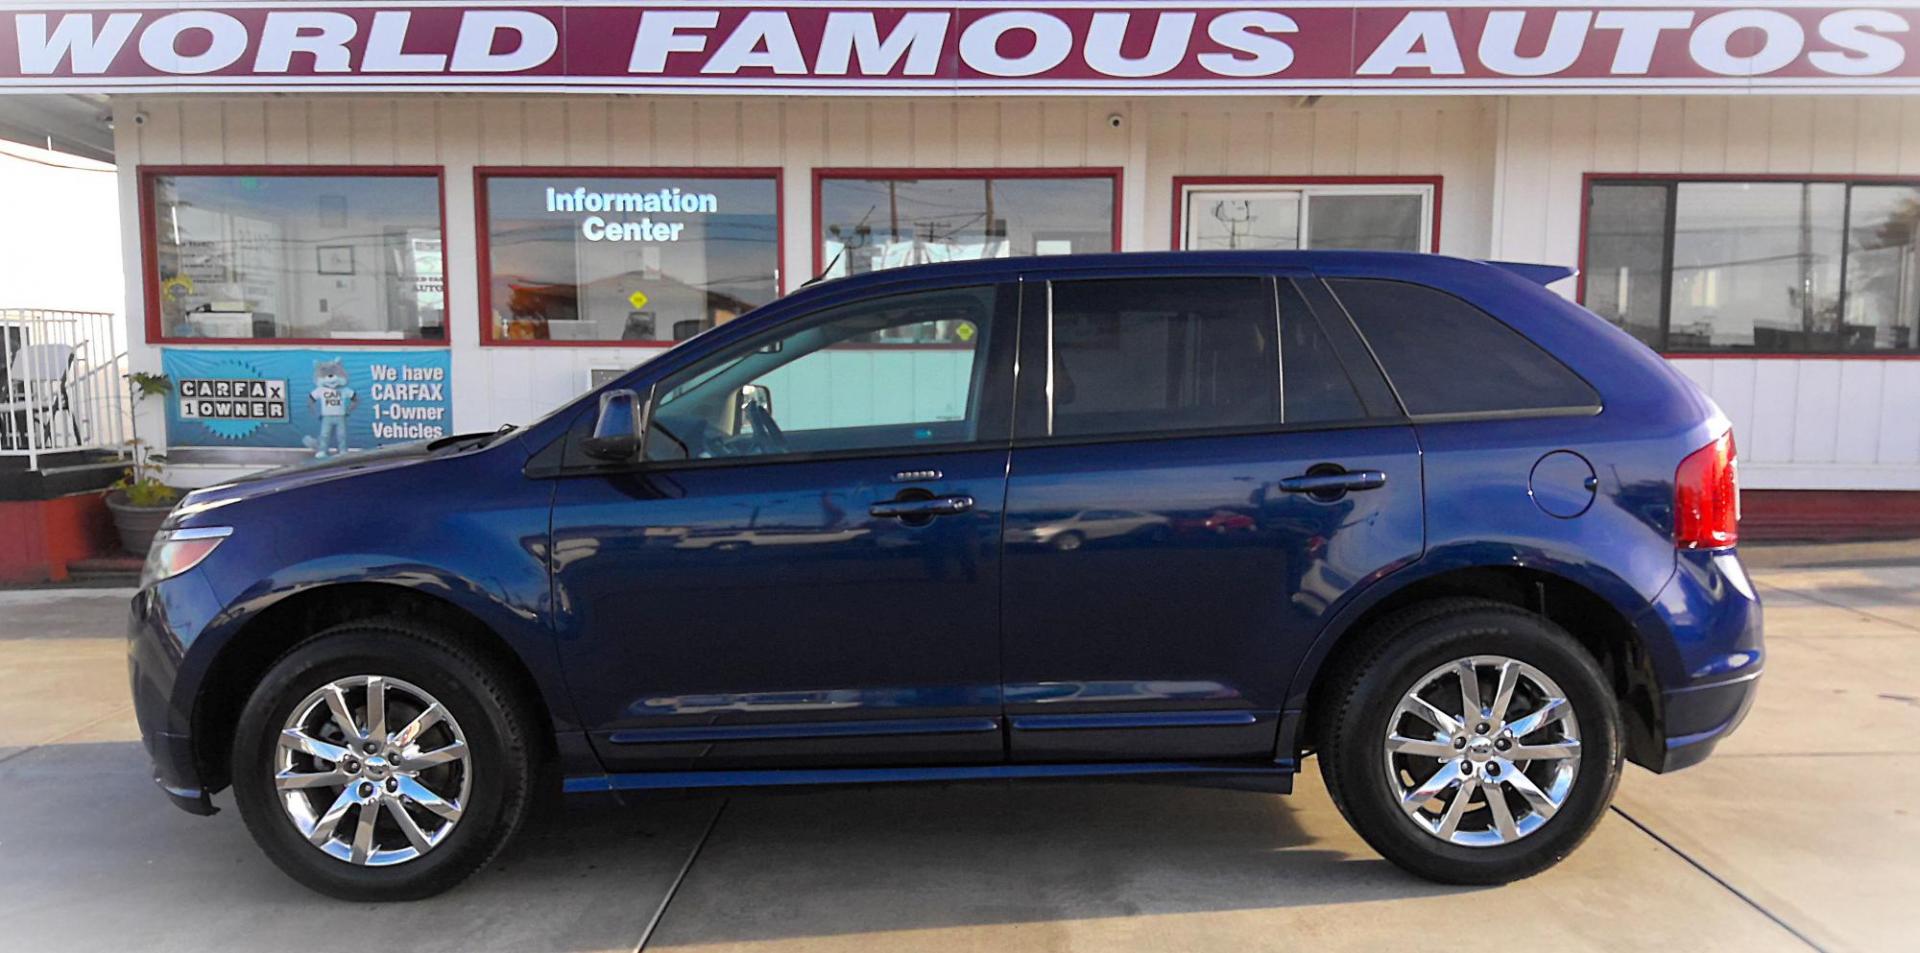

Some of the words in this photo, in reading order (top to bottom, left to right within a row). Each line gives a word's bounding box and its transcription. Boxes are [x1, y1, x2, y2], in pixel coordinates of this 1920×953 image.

[14, 10, 559, 74] WORLD
[627, 10, 1300, 76] FAMOUS
[1355, 10, 1911, 76] AUTOS
[546, 186, 718, 213] Information
[582, 216, 685, 242] Center
[371, 365, 398, 381] We
[402, 365, 444, 381] have
[181, 381, 285, 399] CARFAX
[371, 383, 443, 401] CARFAX
[184, 402, 196, 416] 1
[200, 402, 285, 418] OWNER
[373, 403, 445, 420] 1-Owner
[372, 422, 443, 439] Vehicles
